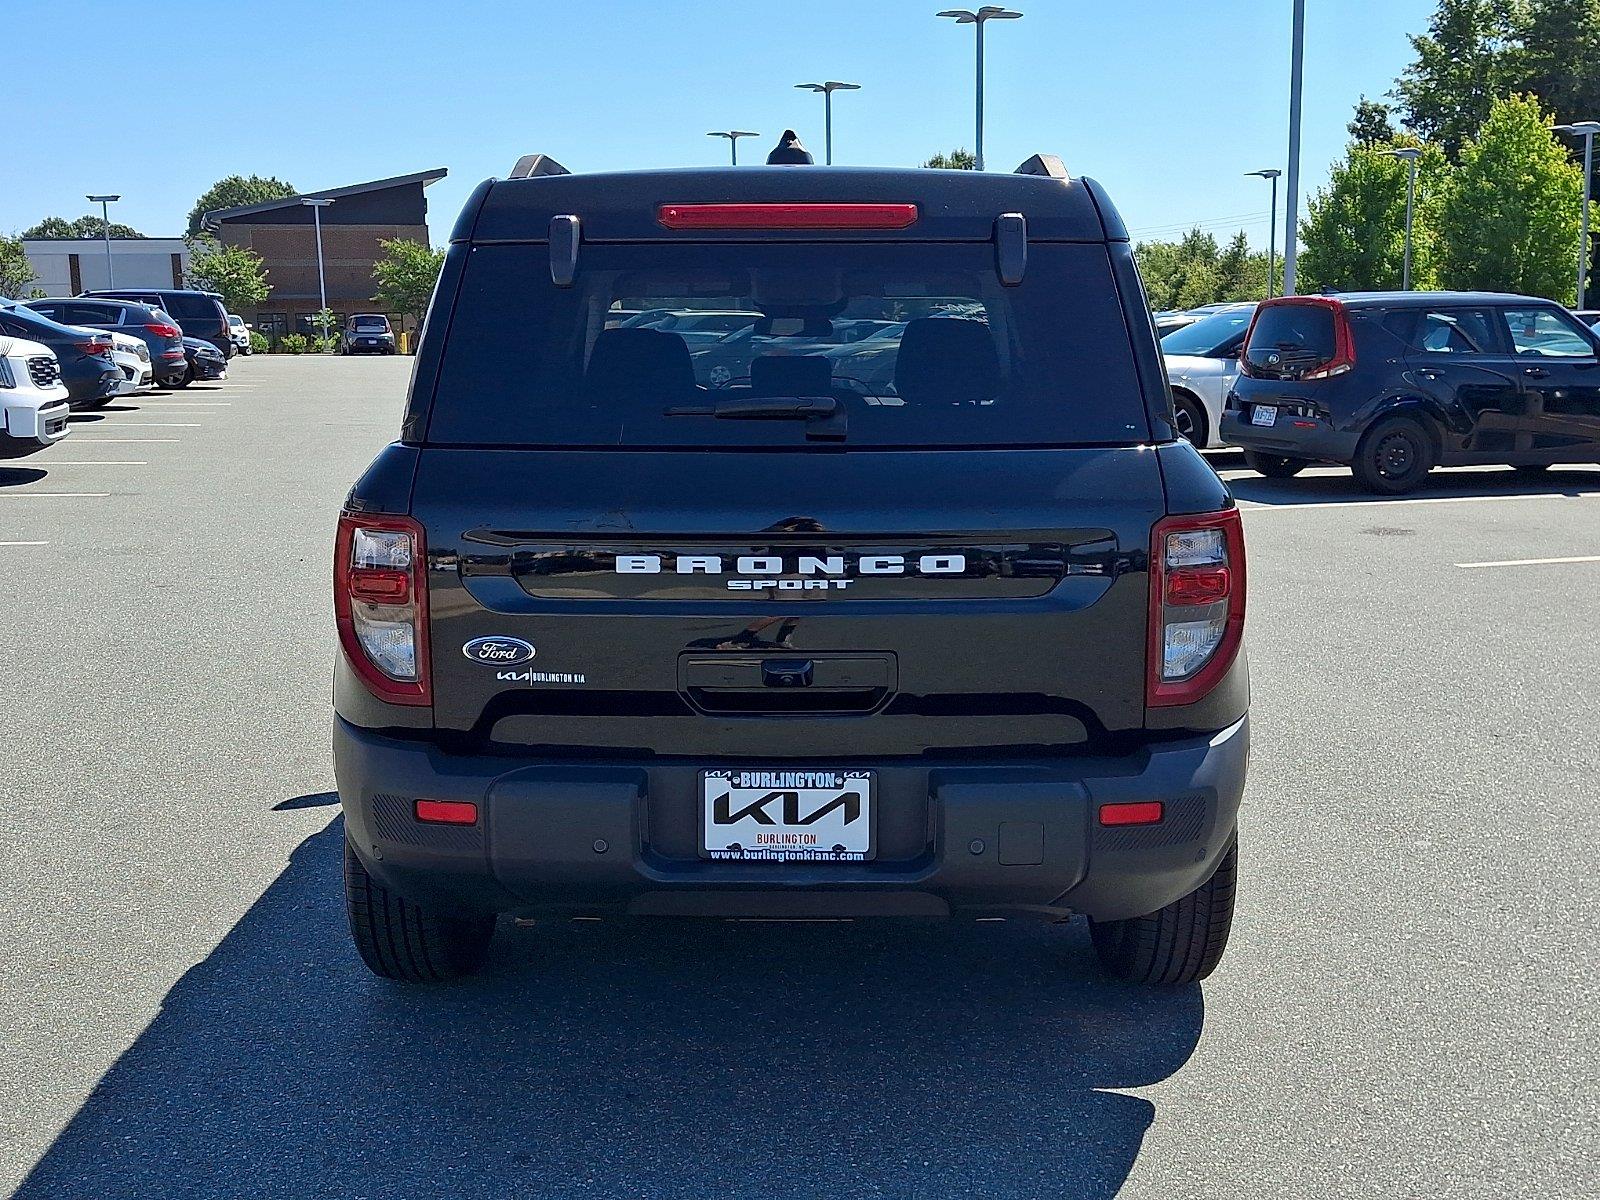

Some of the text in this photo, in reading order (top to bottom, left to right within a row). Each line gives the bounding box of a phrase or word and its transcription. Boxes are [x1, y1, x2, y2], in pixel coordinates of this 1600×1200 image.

[615, 554, 966, 574] BRONCO
[727, 579, 853, 590] SPORT
[478, 642, 517, 659] Ford
[533, 672, 572, 682] BURLINGTON
[574, 674, 586, 683] KIA
[740, 772, 836, 788] BURLINGTON
[714, 792, 860, 826] KIA
[757, 834, 816, 844] BURLINGTON
[711, 850, 864, 862] www.burlingtonkianc.com
